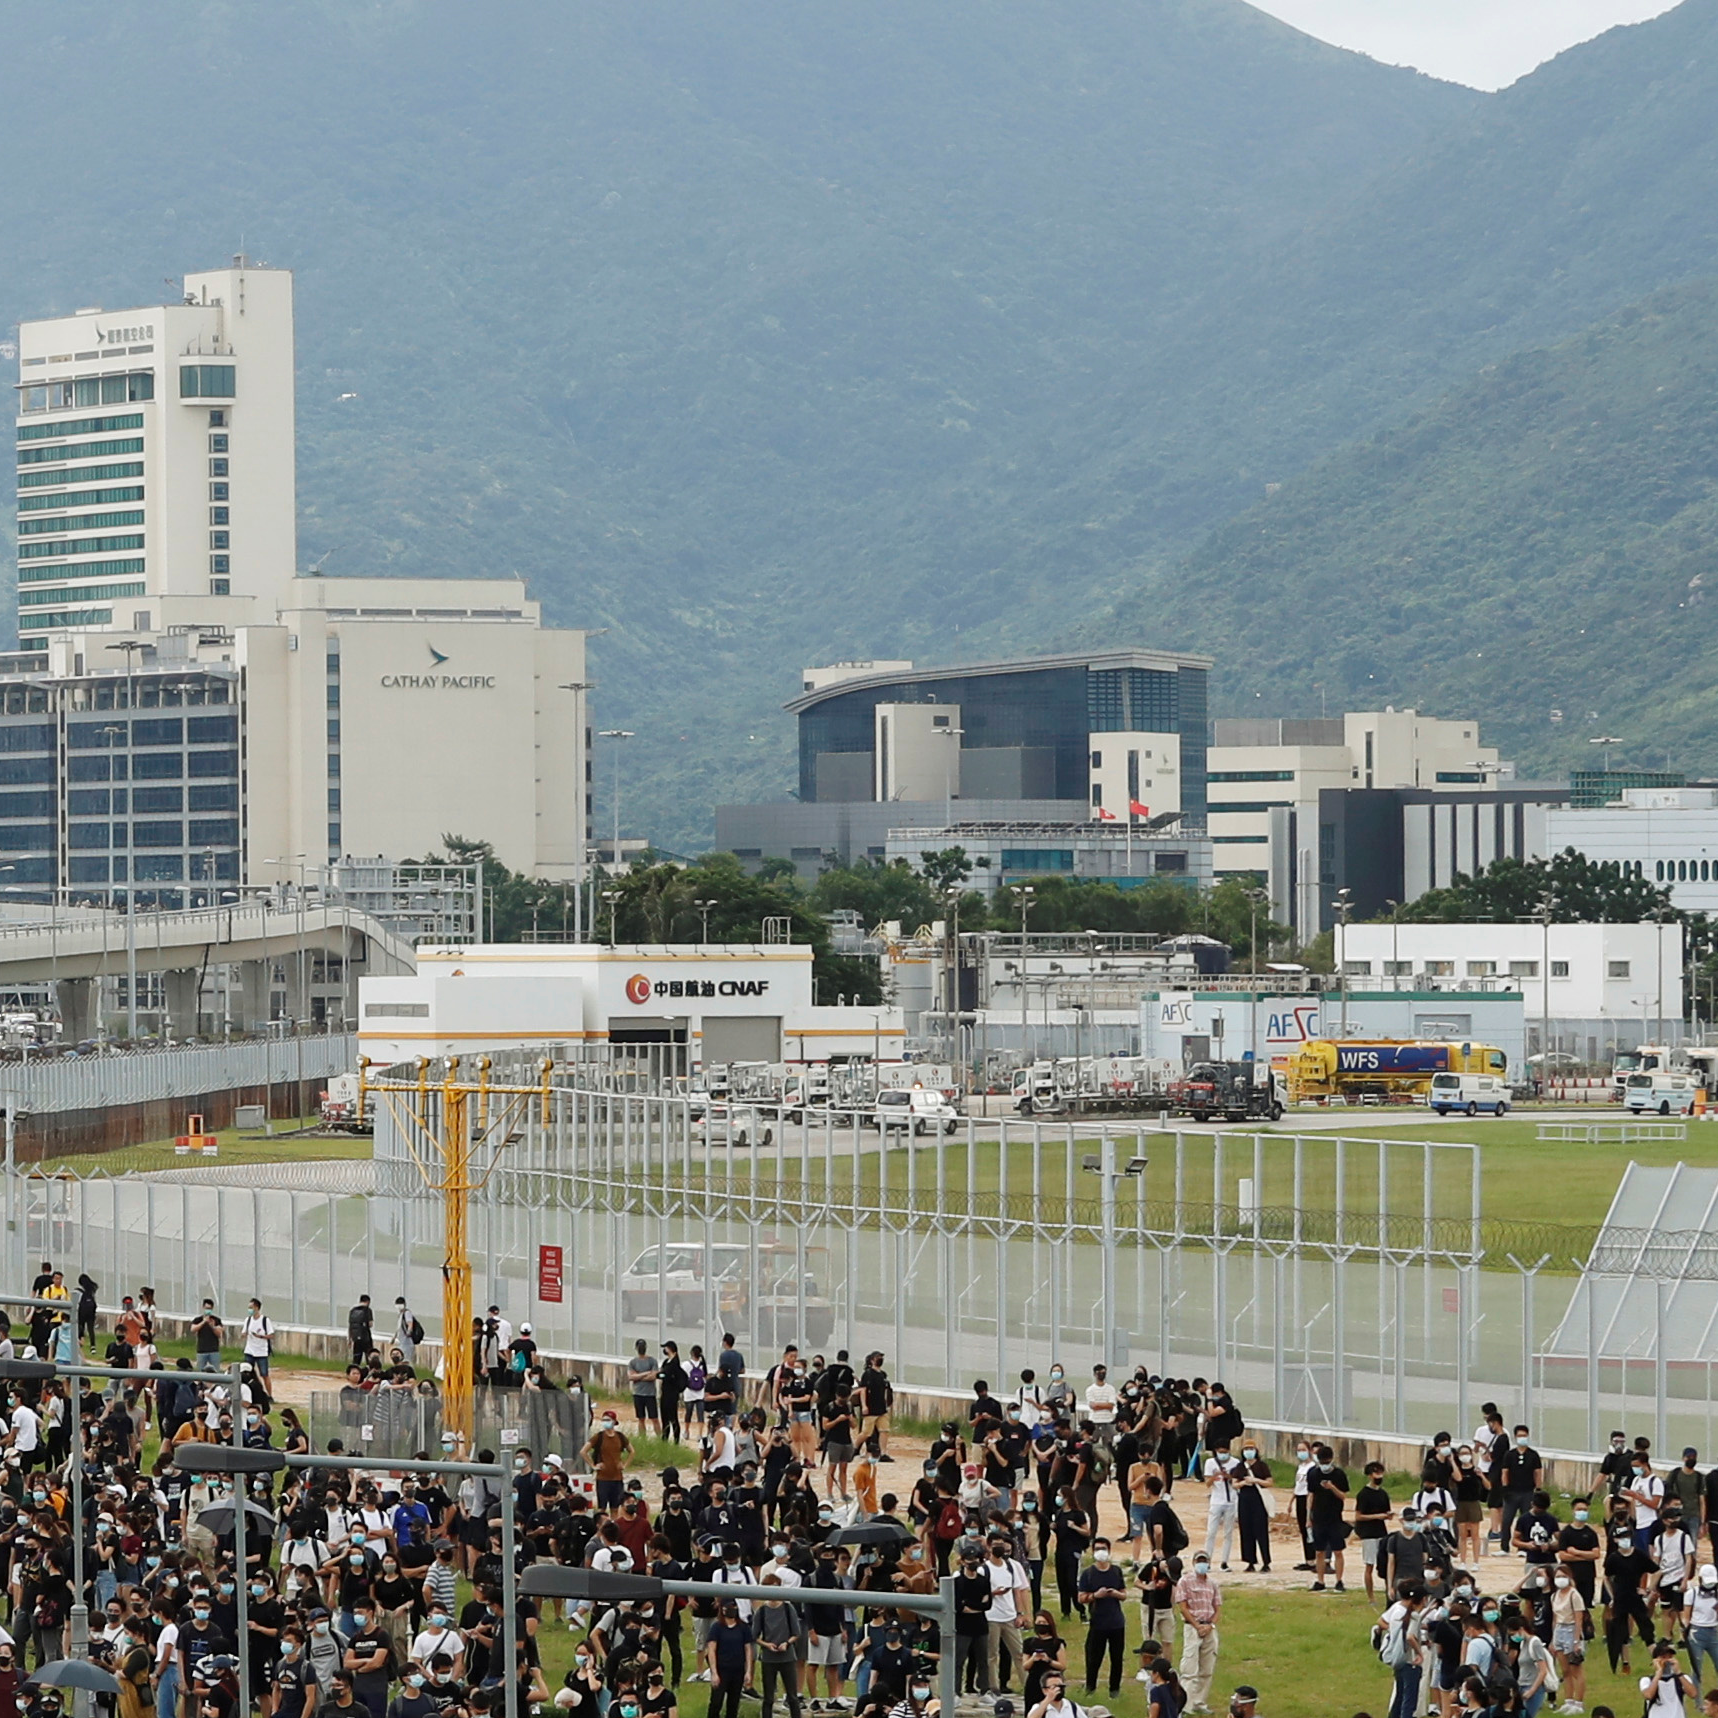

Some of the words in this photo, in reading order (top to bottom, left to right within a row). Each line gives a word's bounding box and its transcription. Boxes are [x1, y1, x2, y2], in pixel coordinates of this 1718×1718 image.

[381, 675, 438, 688] CATHAY
[442, 675, 495, 688] PACIFIC
[654, 980, 715, 997] 中国航油
[719, 980, 769, 996] CNAF
[1161, 1000, 1192, 1025] AFSC
[1266, 1007, 1318, 1043] AFSC
[1342, 1051, 1379, 1069] WFS
